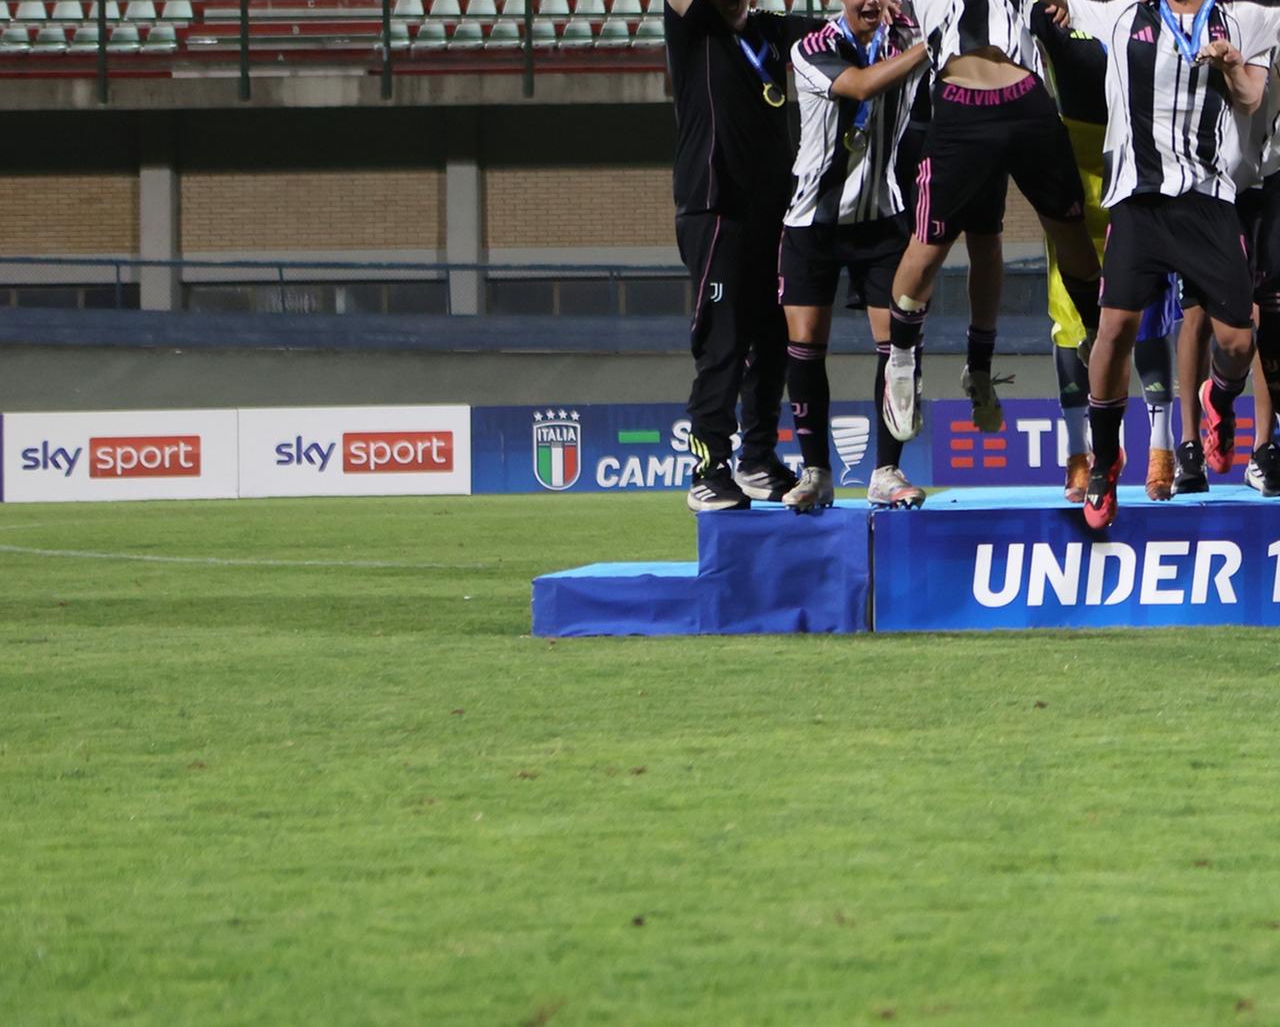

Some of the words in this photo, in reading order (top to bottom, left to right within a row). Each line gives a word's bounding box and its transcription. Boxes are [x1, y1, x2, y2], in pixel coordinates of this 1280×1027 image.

[942, 83, 1000, 106] CALVIN
[1004, 75, 1037, 102] KLEIN
[537, 427, 577, 442] ITALIA
[1016, 419, 1124, 468] TI
[21, 440, 82, 477] sky
[95, 441, 194, 474] sport
[276, 435, 336, 472] sky
[349, 437, 447, 470] sport
[972, 540, 1243, 608] UNDER
